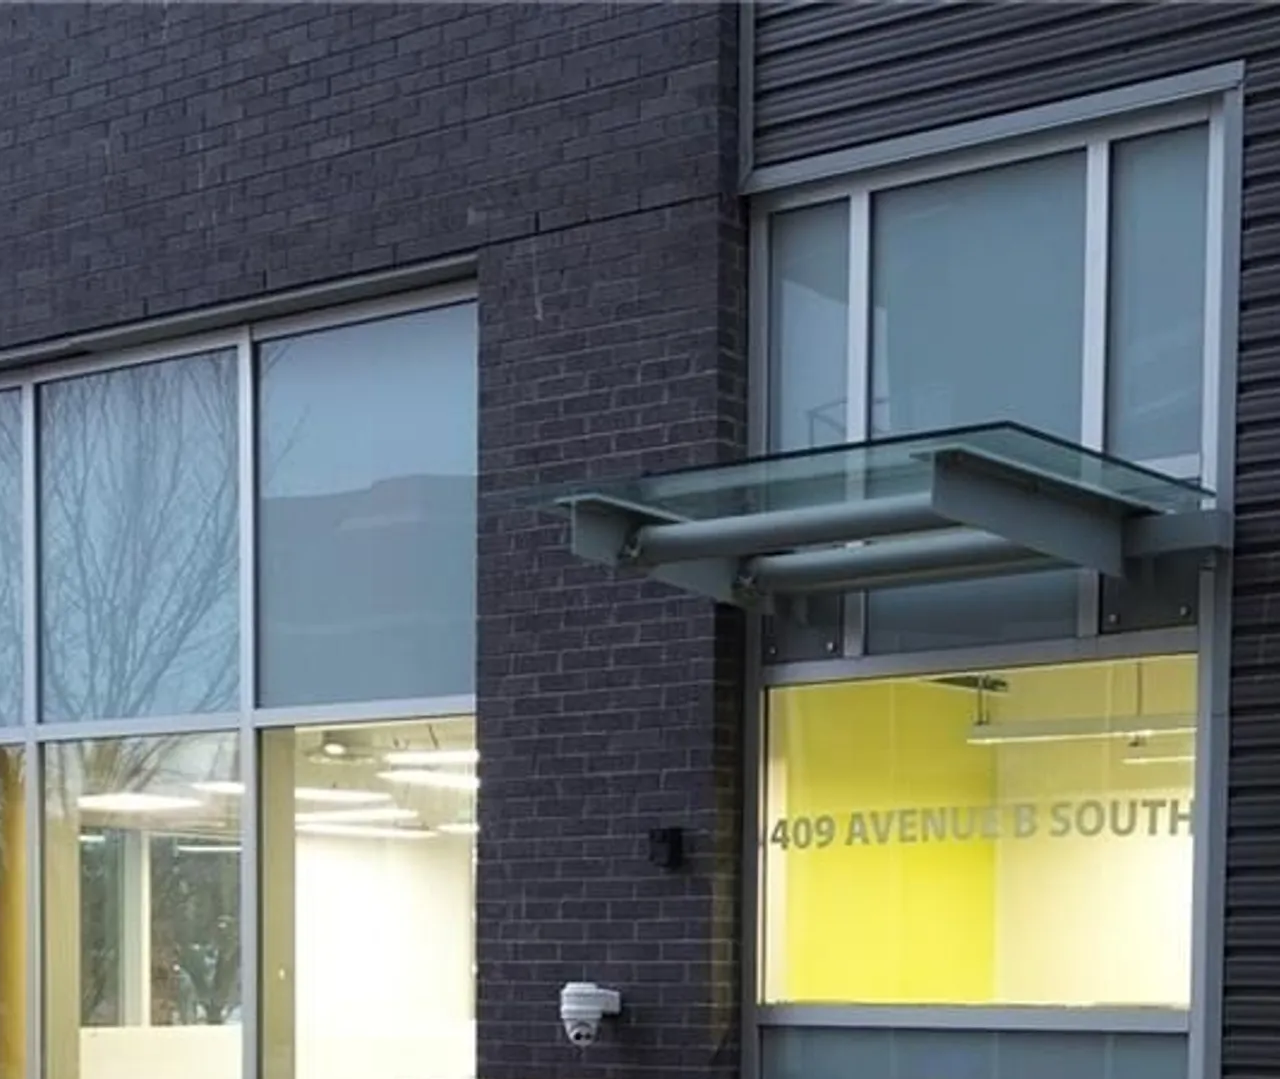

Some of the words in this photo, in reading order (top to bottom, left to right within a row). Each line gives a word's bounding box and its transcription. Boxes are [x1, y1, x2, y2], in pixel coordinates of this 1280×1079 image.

[770, 814, 835, 850] 409
[844, 806, 1001, 846] AVENUE
[1011, 802, 1037, 838] B
[1049, 798, 1196, 838] SOUTH
